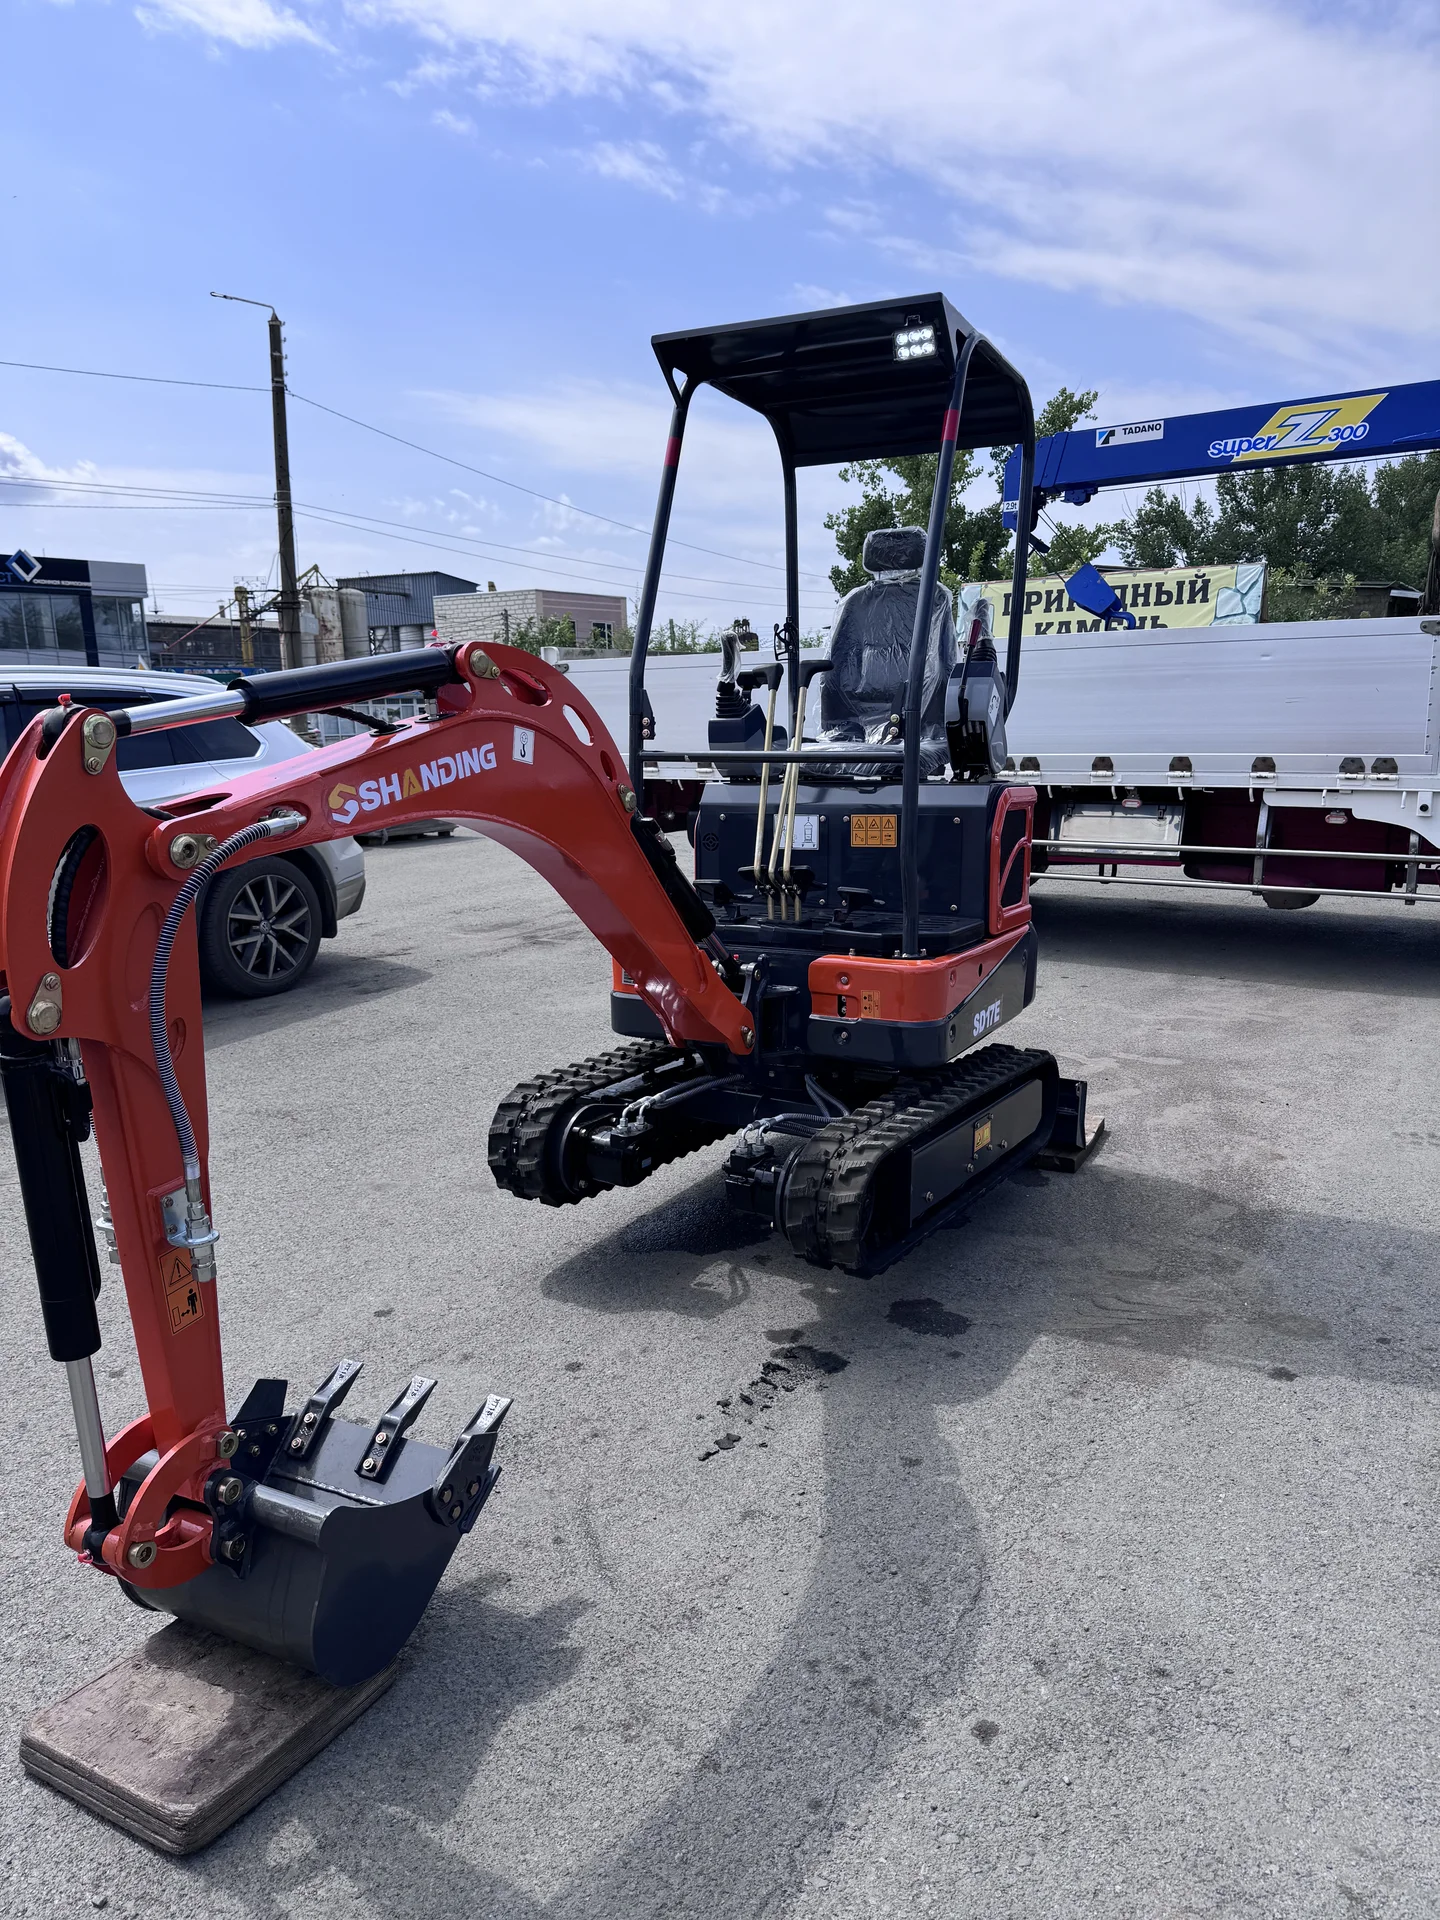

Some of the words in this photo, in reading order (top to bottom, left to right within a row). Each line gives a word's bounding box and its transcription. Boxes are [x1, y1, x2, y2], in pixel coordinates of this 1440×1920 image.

[1122, 423, 1162, 435] TADANO
[1208, 434, 1277, 457] super
[1327, 423, 1369, 443] 300
[358, 742, 497, 811] SHANDING
[973, 1000, 1001, 1037] SD17E
